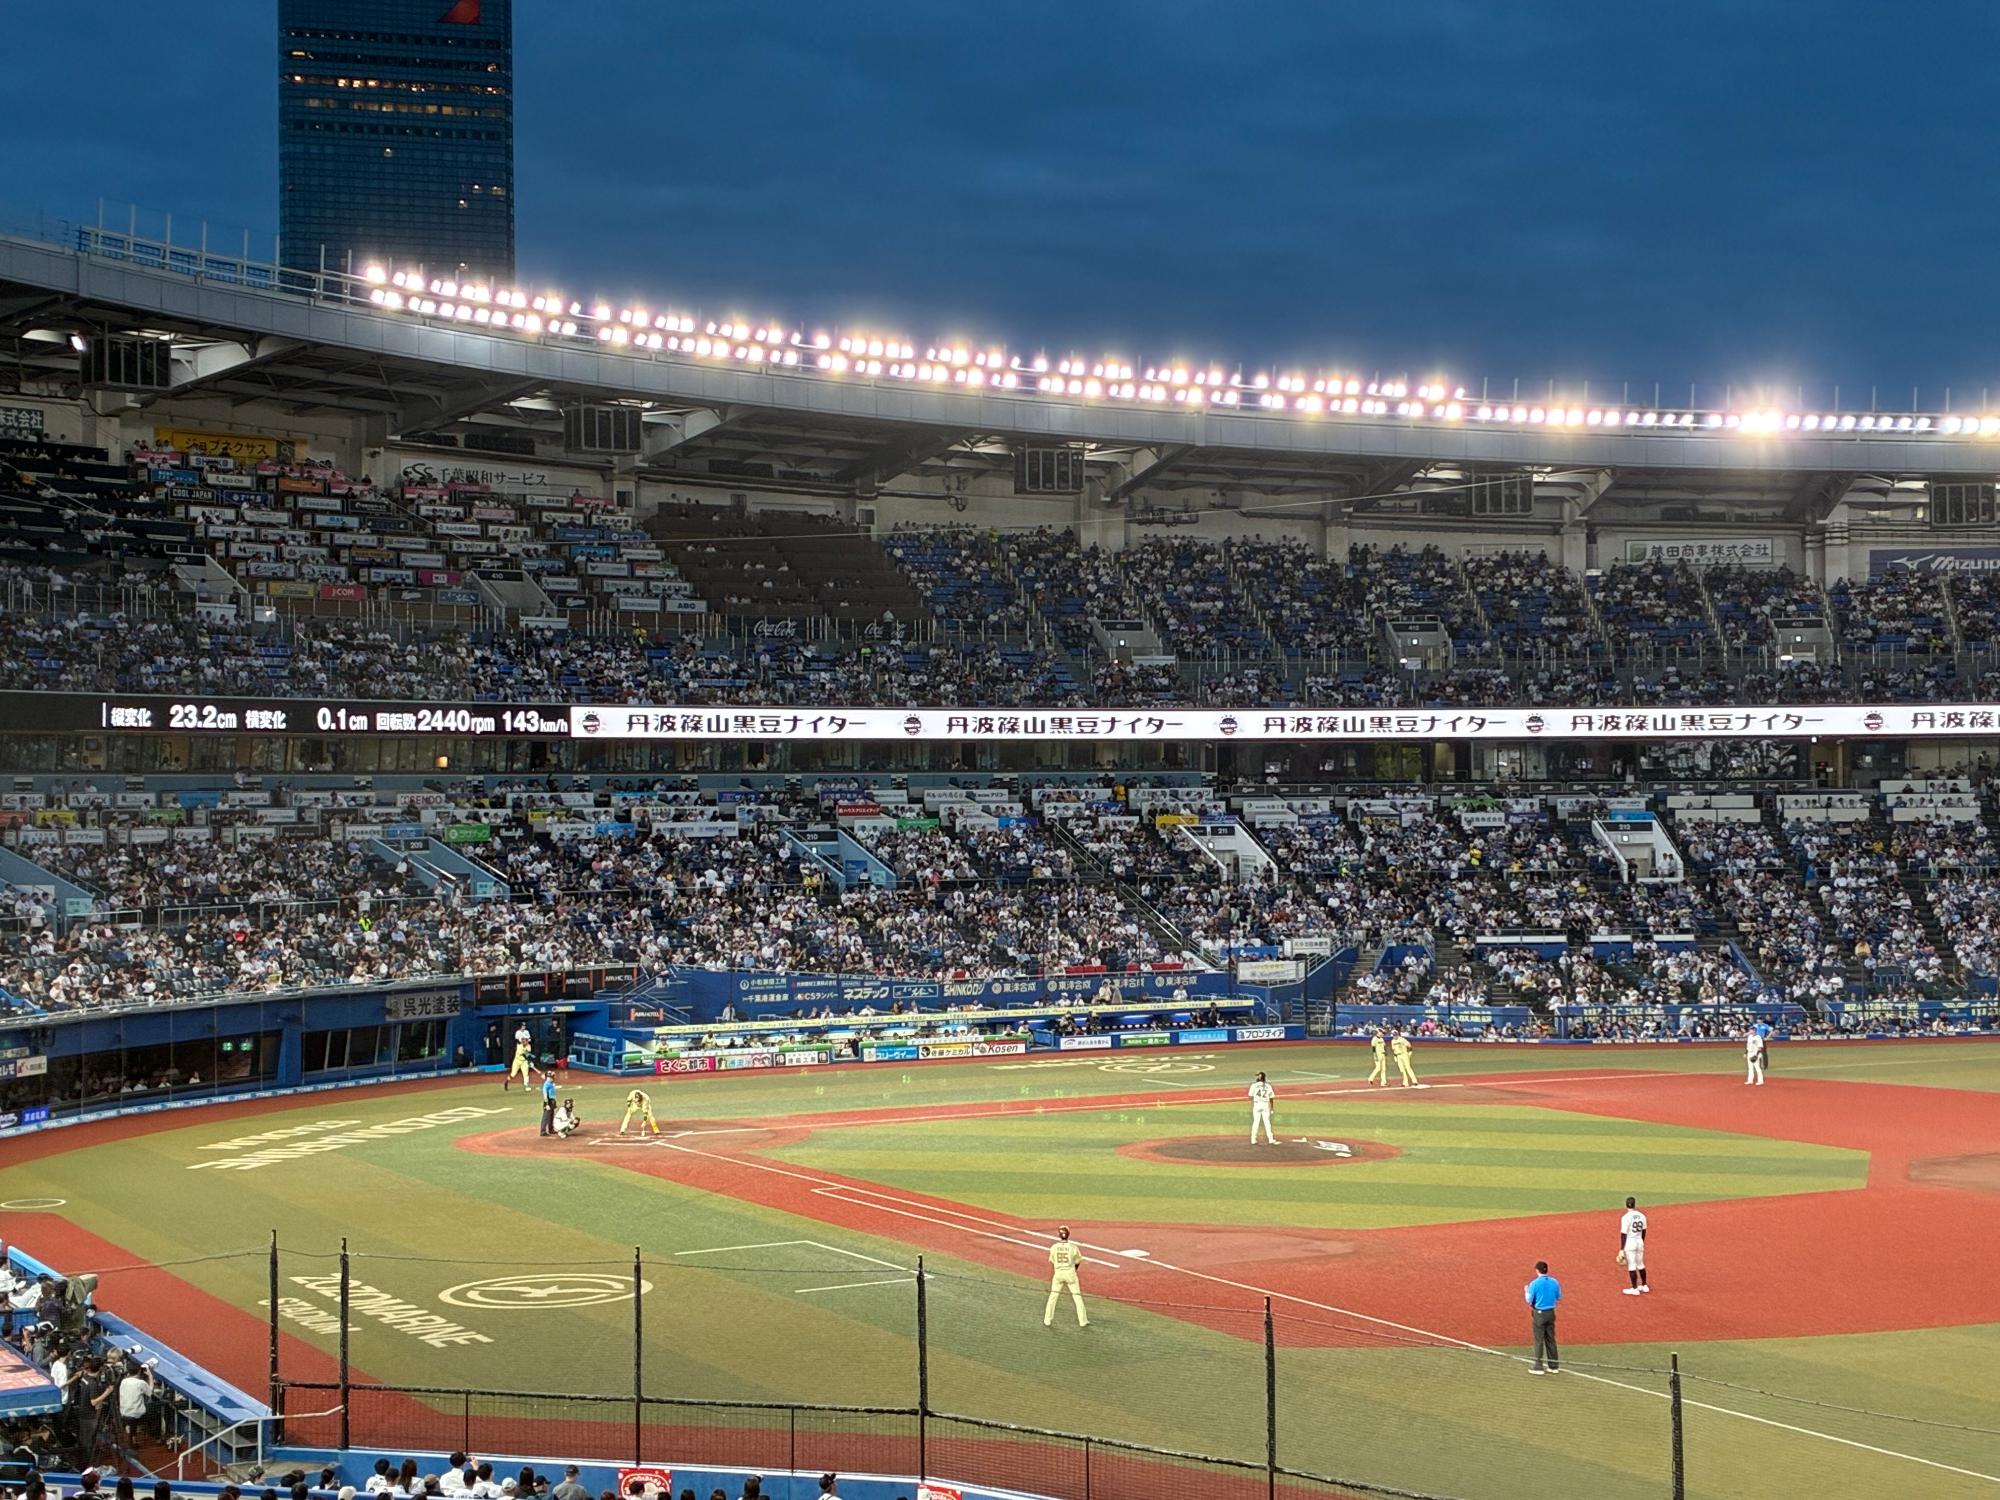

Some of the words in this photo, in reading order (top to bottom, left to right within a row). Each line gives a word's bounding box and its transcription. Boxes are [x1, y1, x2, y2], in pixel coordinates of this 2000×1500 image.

[172, 489, 189, 498] COOL
[191, 490, 212, 499] JAPAN
[376, 712, 416, 732] 回転数
[626, 713, 867, 734] 丹波篠山黒豆ナイター
[946, 715, 1183, 735] 丹波篠山黒豆ナイター
[1263, 714, 1507, 735] 丹波篠山黒豆ナイター
[1570, 712, 1825, 733] 丹波篠山黒豆ナイター
[1912, 711, 2000, 731] 丹波篠
[411, 841, 423, 849] 209
[1058, 980, 1091, 990] 東洋合成
[1166, 976, 1197, 986] 東洋合成
[1003, 982, 1036, 992] 東洋合成
[843, 987, 890, 1000] ネステック
[403, 995, 460, 1016] 呉光塗装
[1246, 1028, 1284, 1039] フロンティア
[931, 1049, 971, 1057] 佐藤ケミカル
[988, 1043, 1018, 1053] Kosen
[661, 1058, 709, 1072] さくら都市
[1256, 1089, 1267, 1098] 42
[1057, 1252, 1069, 1263] 85
